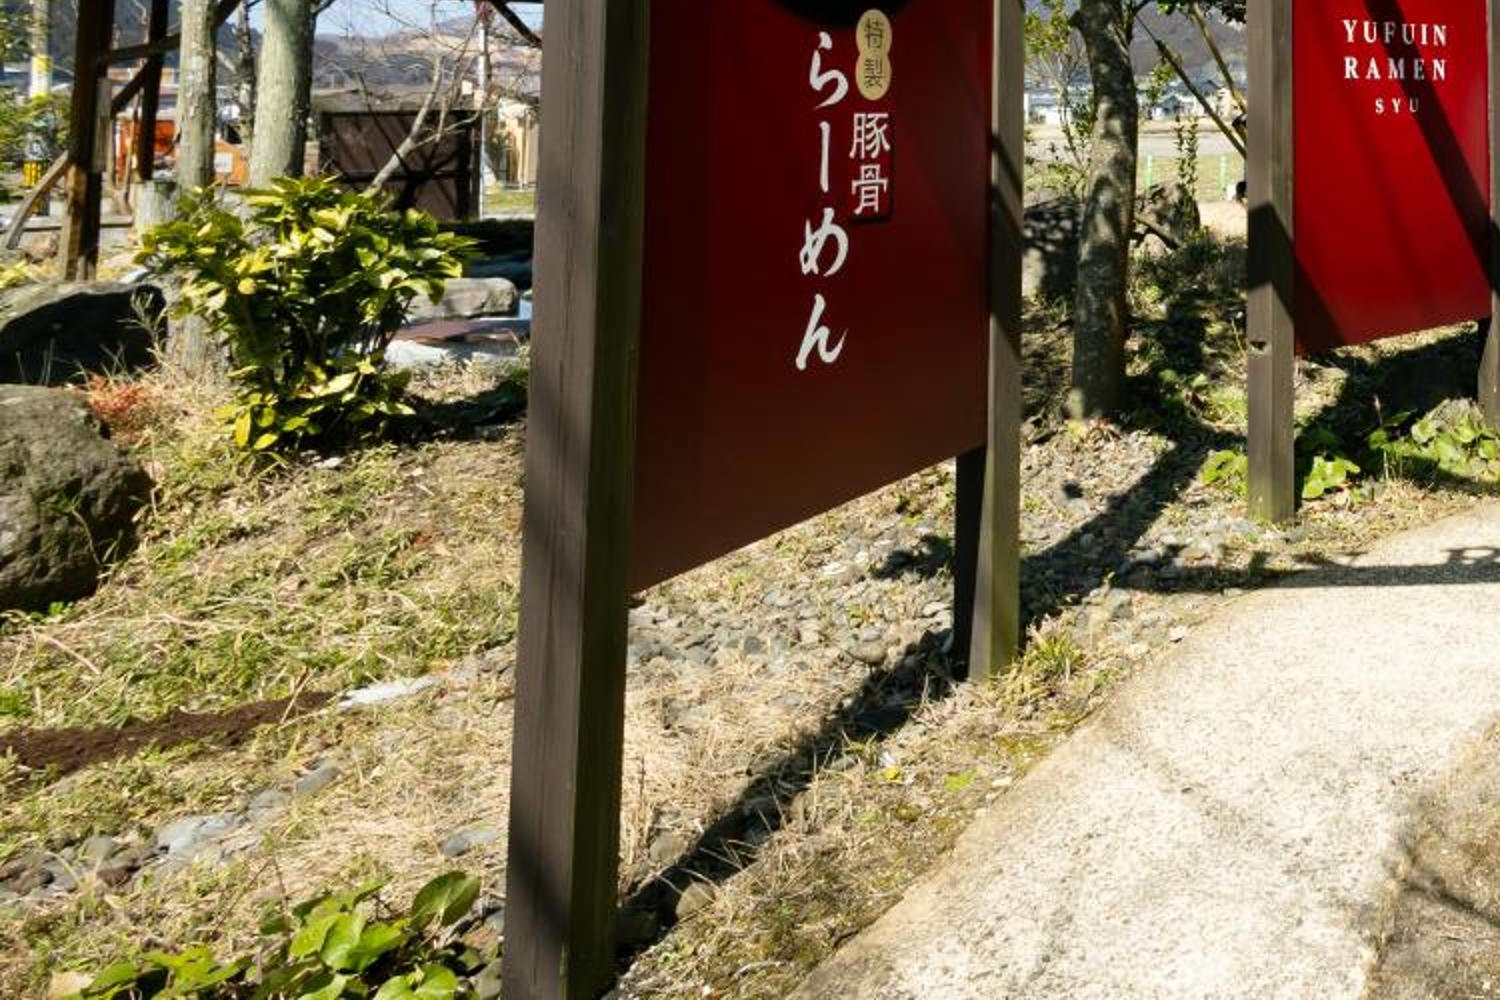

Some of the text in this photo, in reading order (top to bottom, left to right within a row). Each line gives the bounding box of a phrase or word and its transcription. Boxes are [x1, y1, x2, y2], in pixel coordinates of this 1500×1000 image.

[1343, 18, 1447, 46] YUFUIN
[1344, 56, 1447, 81] RAMEN
[1375, 97, 1419, 114] SYU
[849, 111, 891, 216] 豚骨
[795, 30, 850, 371] らーめん
